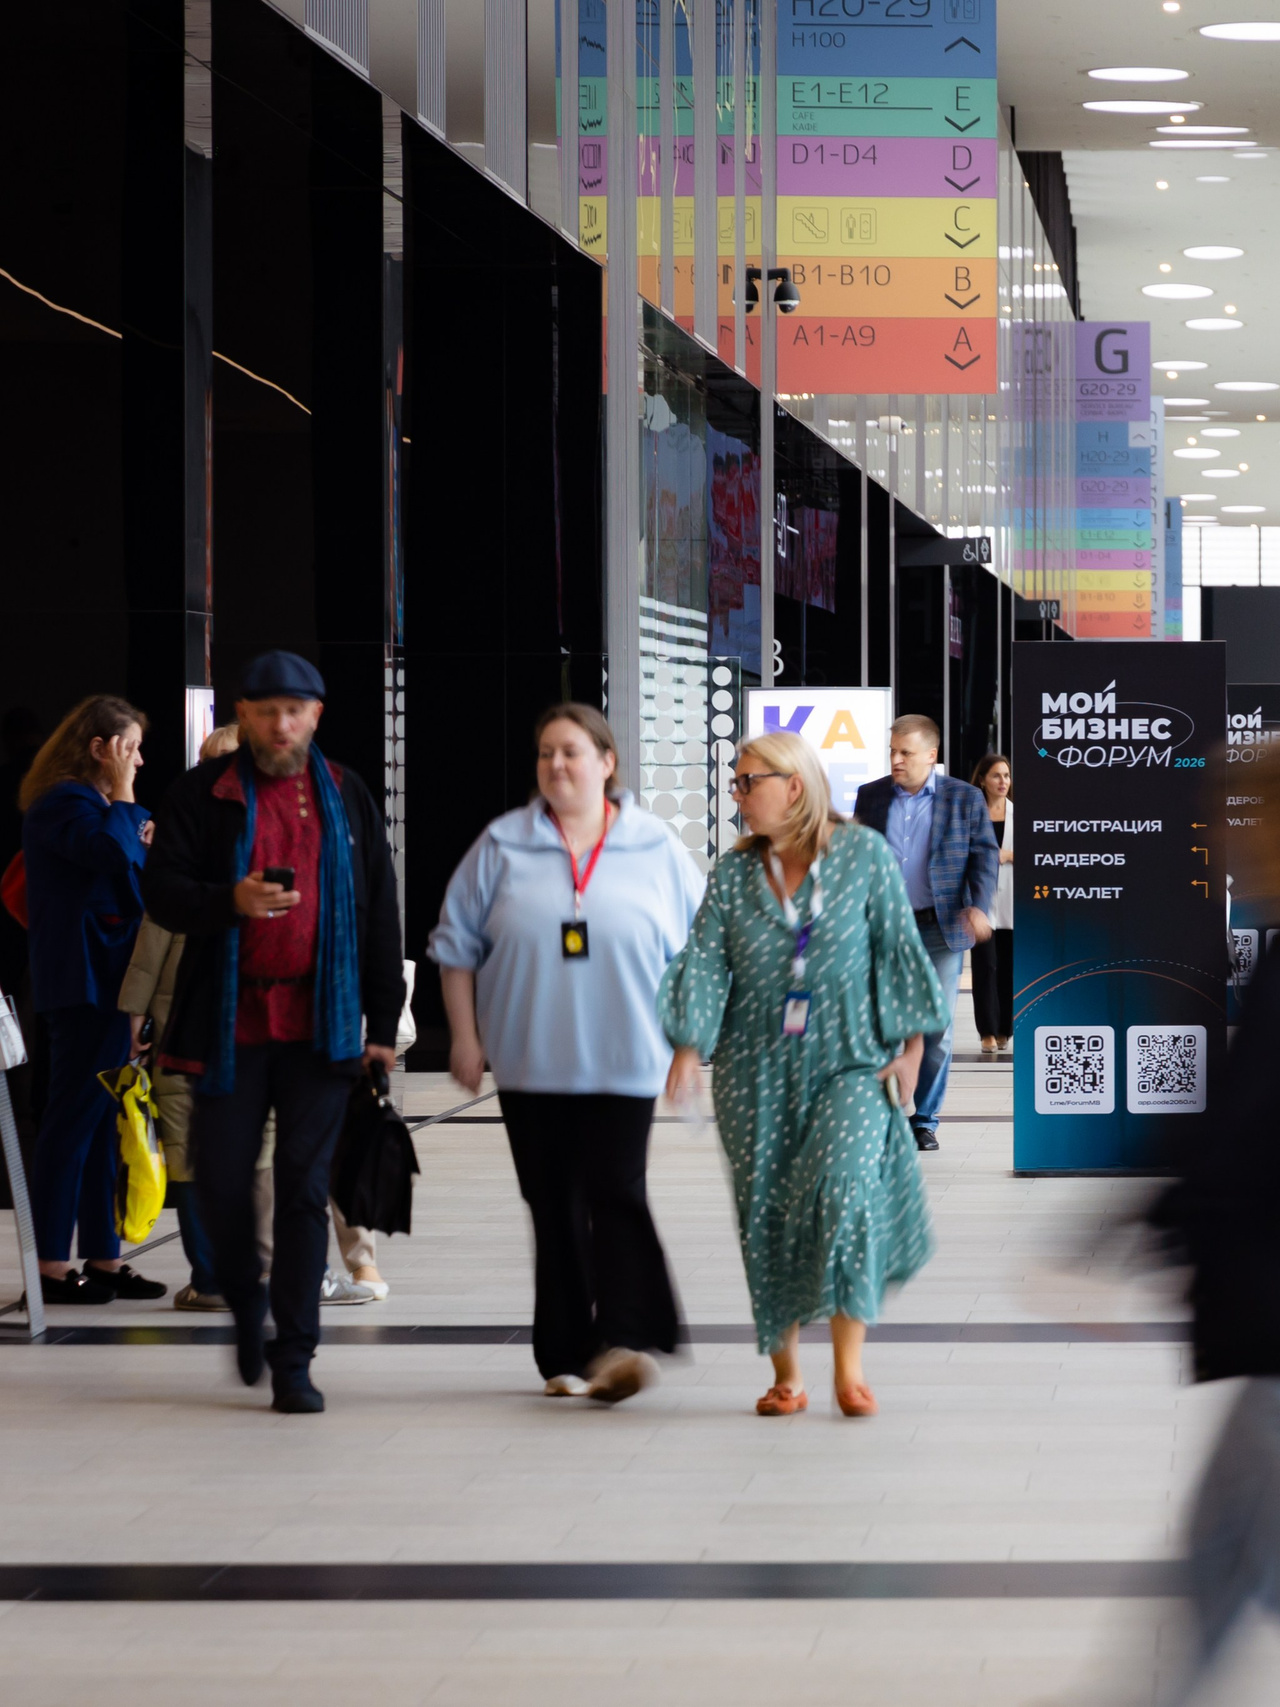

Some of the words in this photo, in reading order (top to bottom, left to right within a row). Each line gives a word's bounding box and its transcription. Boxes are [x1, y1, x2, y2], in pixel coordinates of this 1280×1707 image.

[792, 31, 846, 48] H100
[792, 82, 889, 104] E1-E12
[955, 86, 971, 111] E
[792, 143, 878, 166] D1-D4
[952, 145, 972, 171] D
[953, 206, 971, 232] C
[792, 264, 892, 286] B1-B10
[954, 266, 972, 292] B
[793, 324, 876, 347] A1-A9
[953, 326, 973, 352] A
[1095, 328, 1129, 374] G
[1080, 383, 1136, 396] G20-29
[1098, 431, 1109, 442] H
[1080, 450, 1130, 462] H20-29
[1042, 679, 1116, 714] МОЙ
[1227, 706, 1262, 729] ОЙ
[1042, 718, 1172, 740] БИЗНЕС
[1057, 745, 1172, 768] ФОРУМ
[1174, 758, 1206, 768] 2026
[1226, 748, 1268, 763] ФОР
[1226, 796, 1265, 806] ДЕРОБ
[1033, 820, 1163, 834] РЕГИСТРАЦИЯ
[1226, 818, 1263, 827] УАЛЕТ
[1034, 853, 1126, 867] ГАРДЕРОБ
[1053, 887, 1124, 899] ТУАЛЕТ
